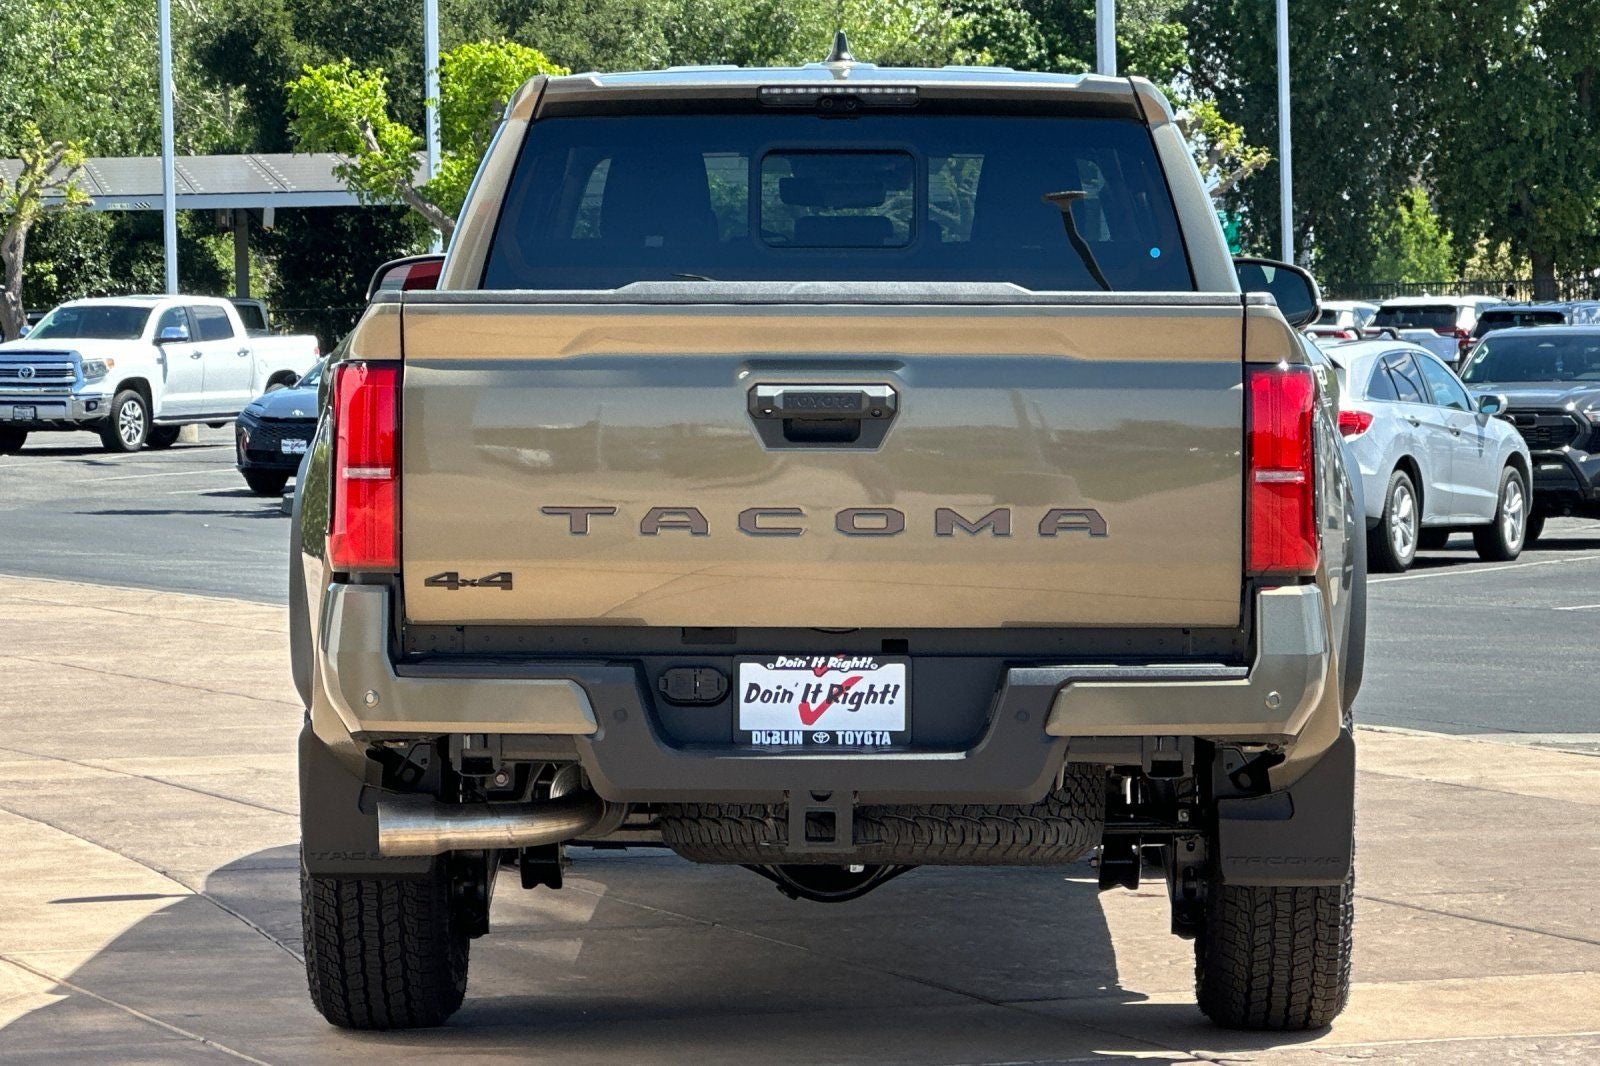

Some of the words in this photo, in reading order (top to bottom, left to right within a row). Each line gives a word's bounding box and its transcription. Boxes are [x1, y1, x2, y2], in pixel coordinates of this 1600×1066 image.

[541, 505, 1108, 537] TACOMA
[424, 571, 513, 591] 4x4
[775, 655, 810, 668] Doin'
[811, 656, 826, 669] It
[827, 656, 873, 672] Right!
[744, 682, 799, 704] Doin'
[801, 683, 823, 704] It
[826, 683, 901, 713] Right!
[752, 730, 803, 745] DUBLIN
[836, 730, 892, 746] TOYOTA
[1226, 855, 1342, 865] TACOMA
